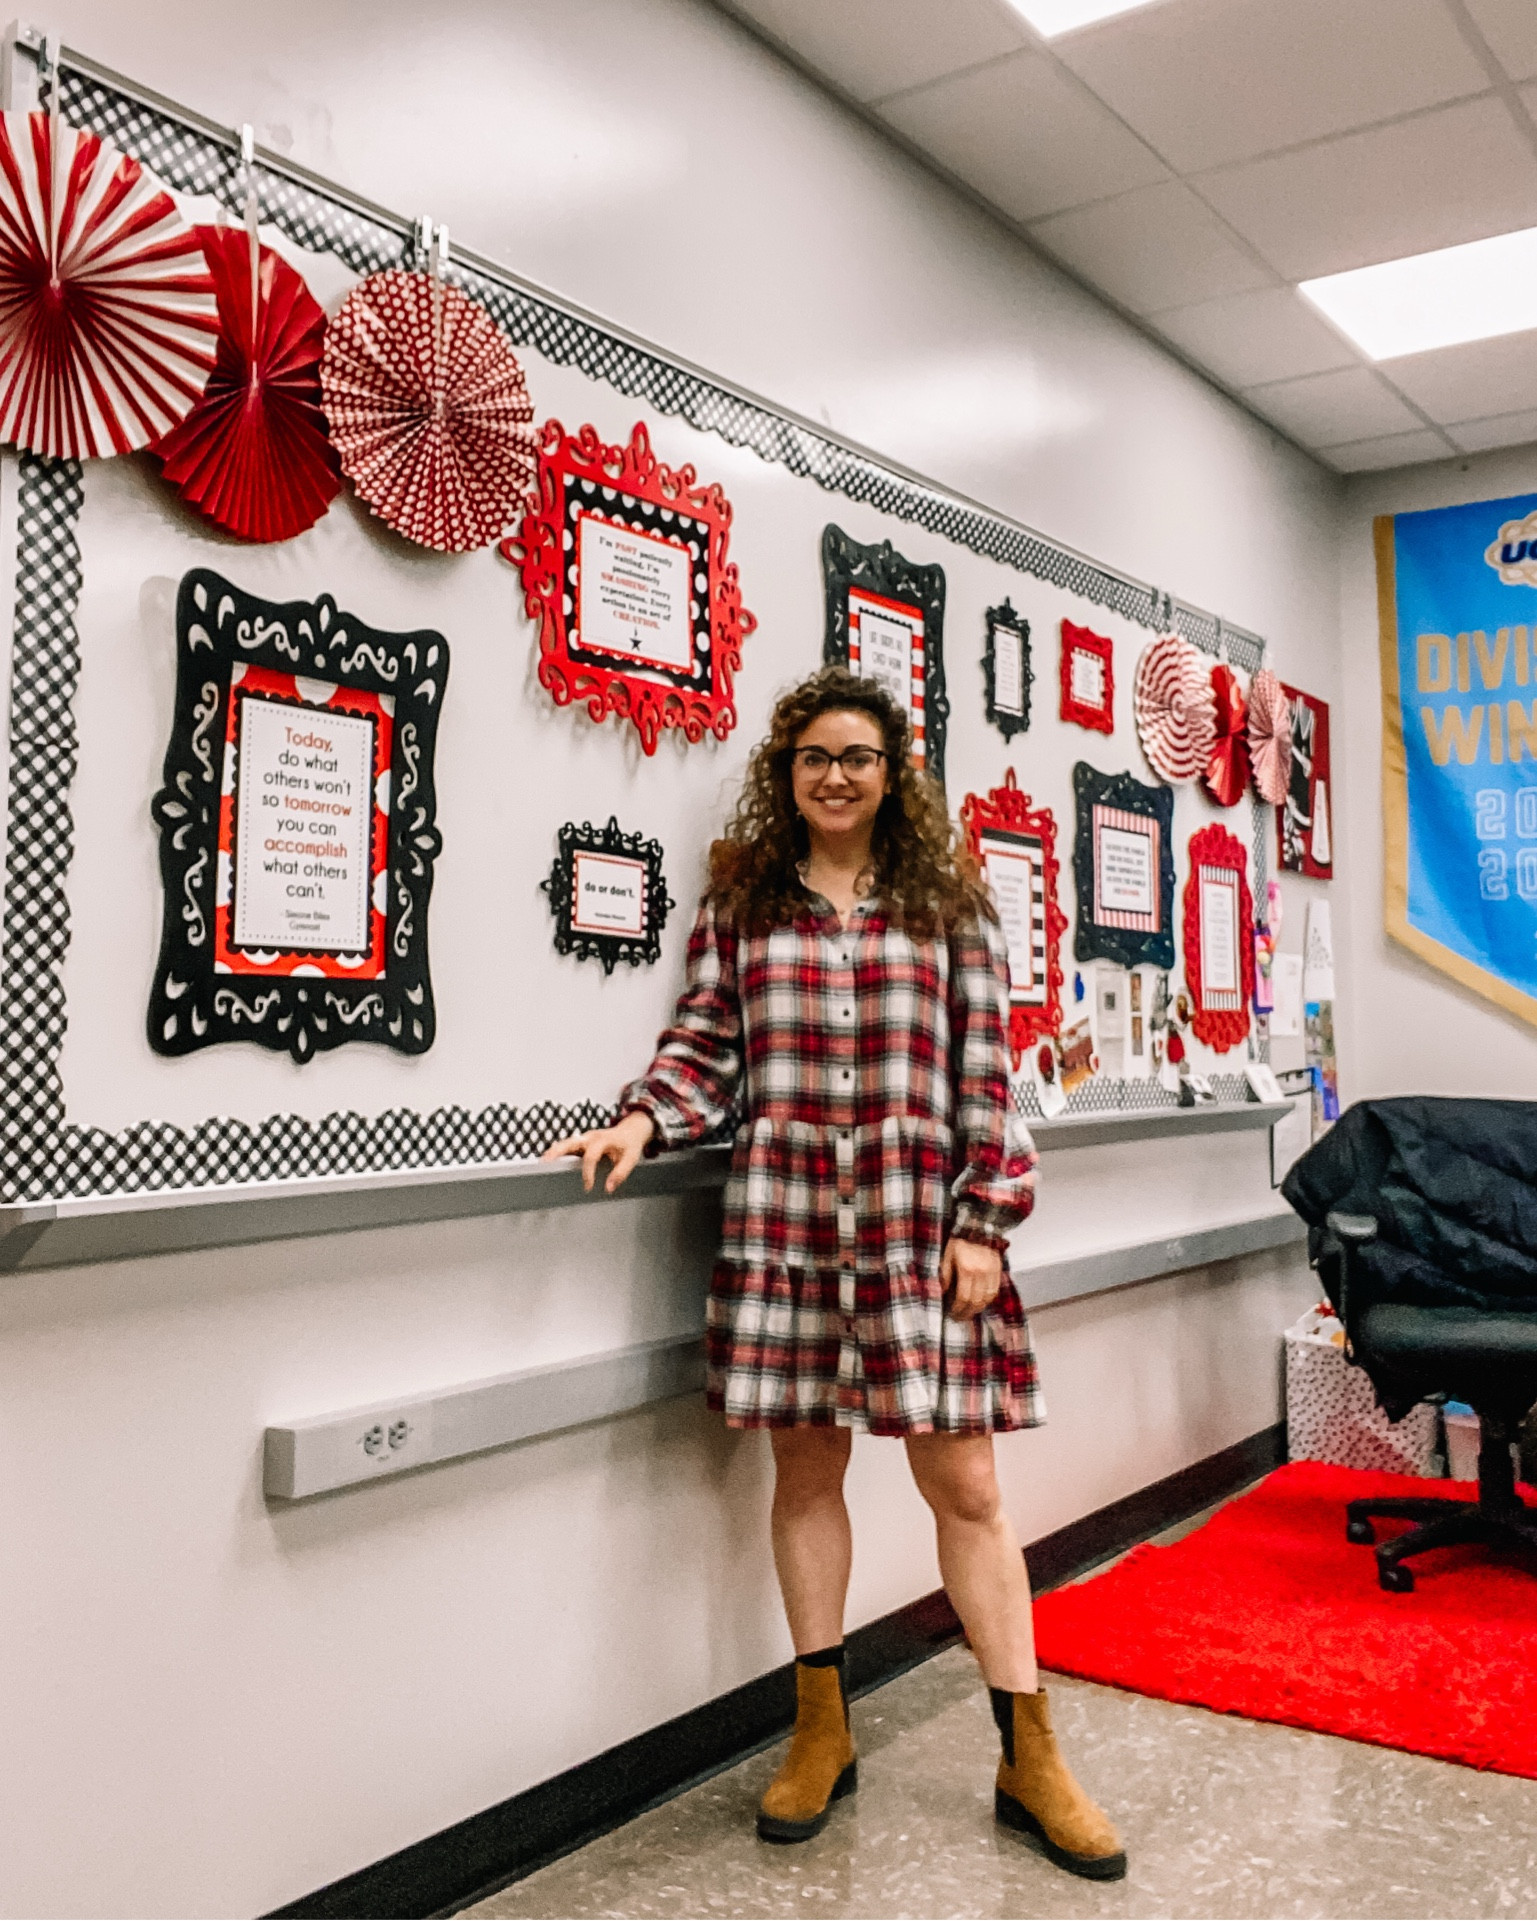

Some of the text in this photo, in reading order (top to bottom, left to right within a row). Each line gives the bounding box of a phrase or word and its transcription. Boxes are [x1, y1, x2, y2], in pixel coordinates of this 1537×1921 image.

[600, 536, 612, 547] I'm
[640, 552, 672, 568] patiently
[648, 564, 659, 574] I'm
[651, 589, 670, 600] every
[1417, 625, 1537, 693] DIVI
[285, 727, 333, 752] Today,
[279, 750, 337, 772] do what
[264, 771, 351, 795] others won't
[262, 794, 351, 817] so tomorrow
[277, 818, 336, 836] you can
[264, 838, 347, 858] accomplish
[264, 859, 347, 879] what others
[286, 882, 325, 899] can't.
[585, 882, 595, 891] do
[610, 886, 634, 898] don't.
